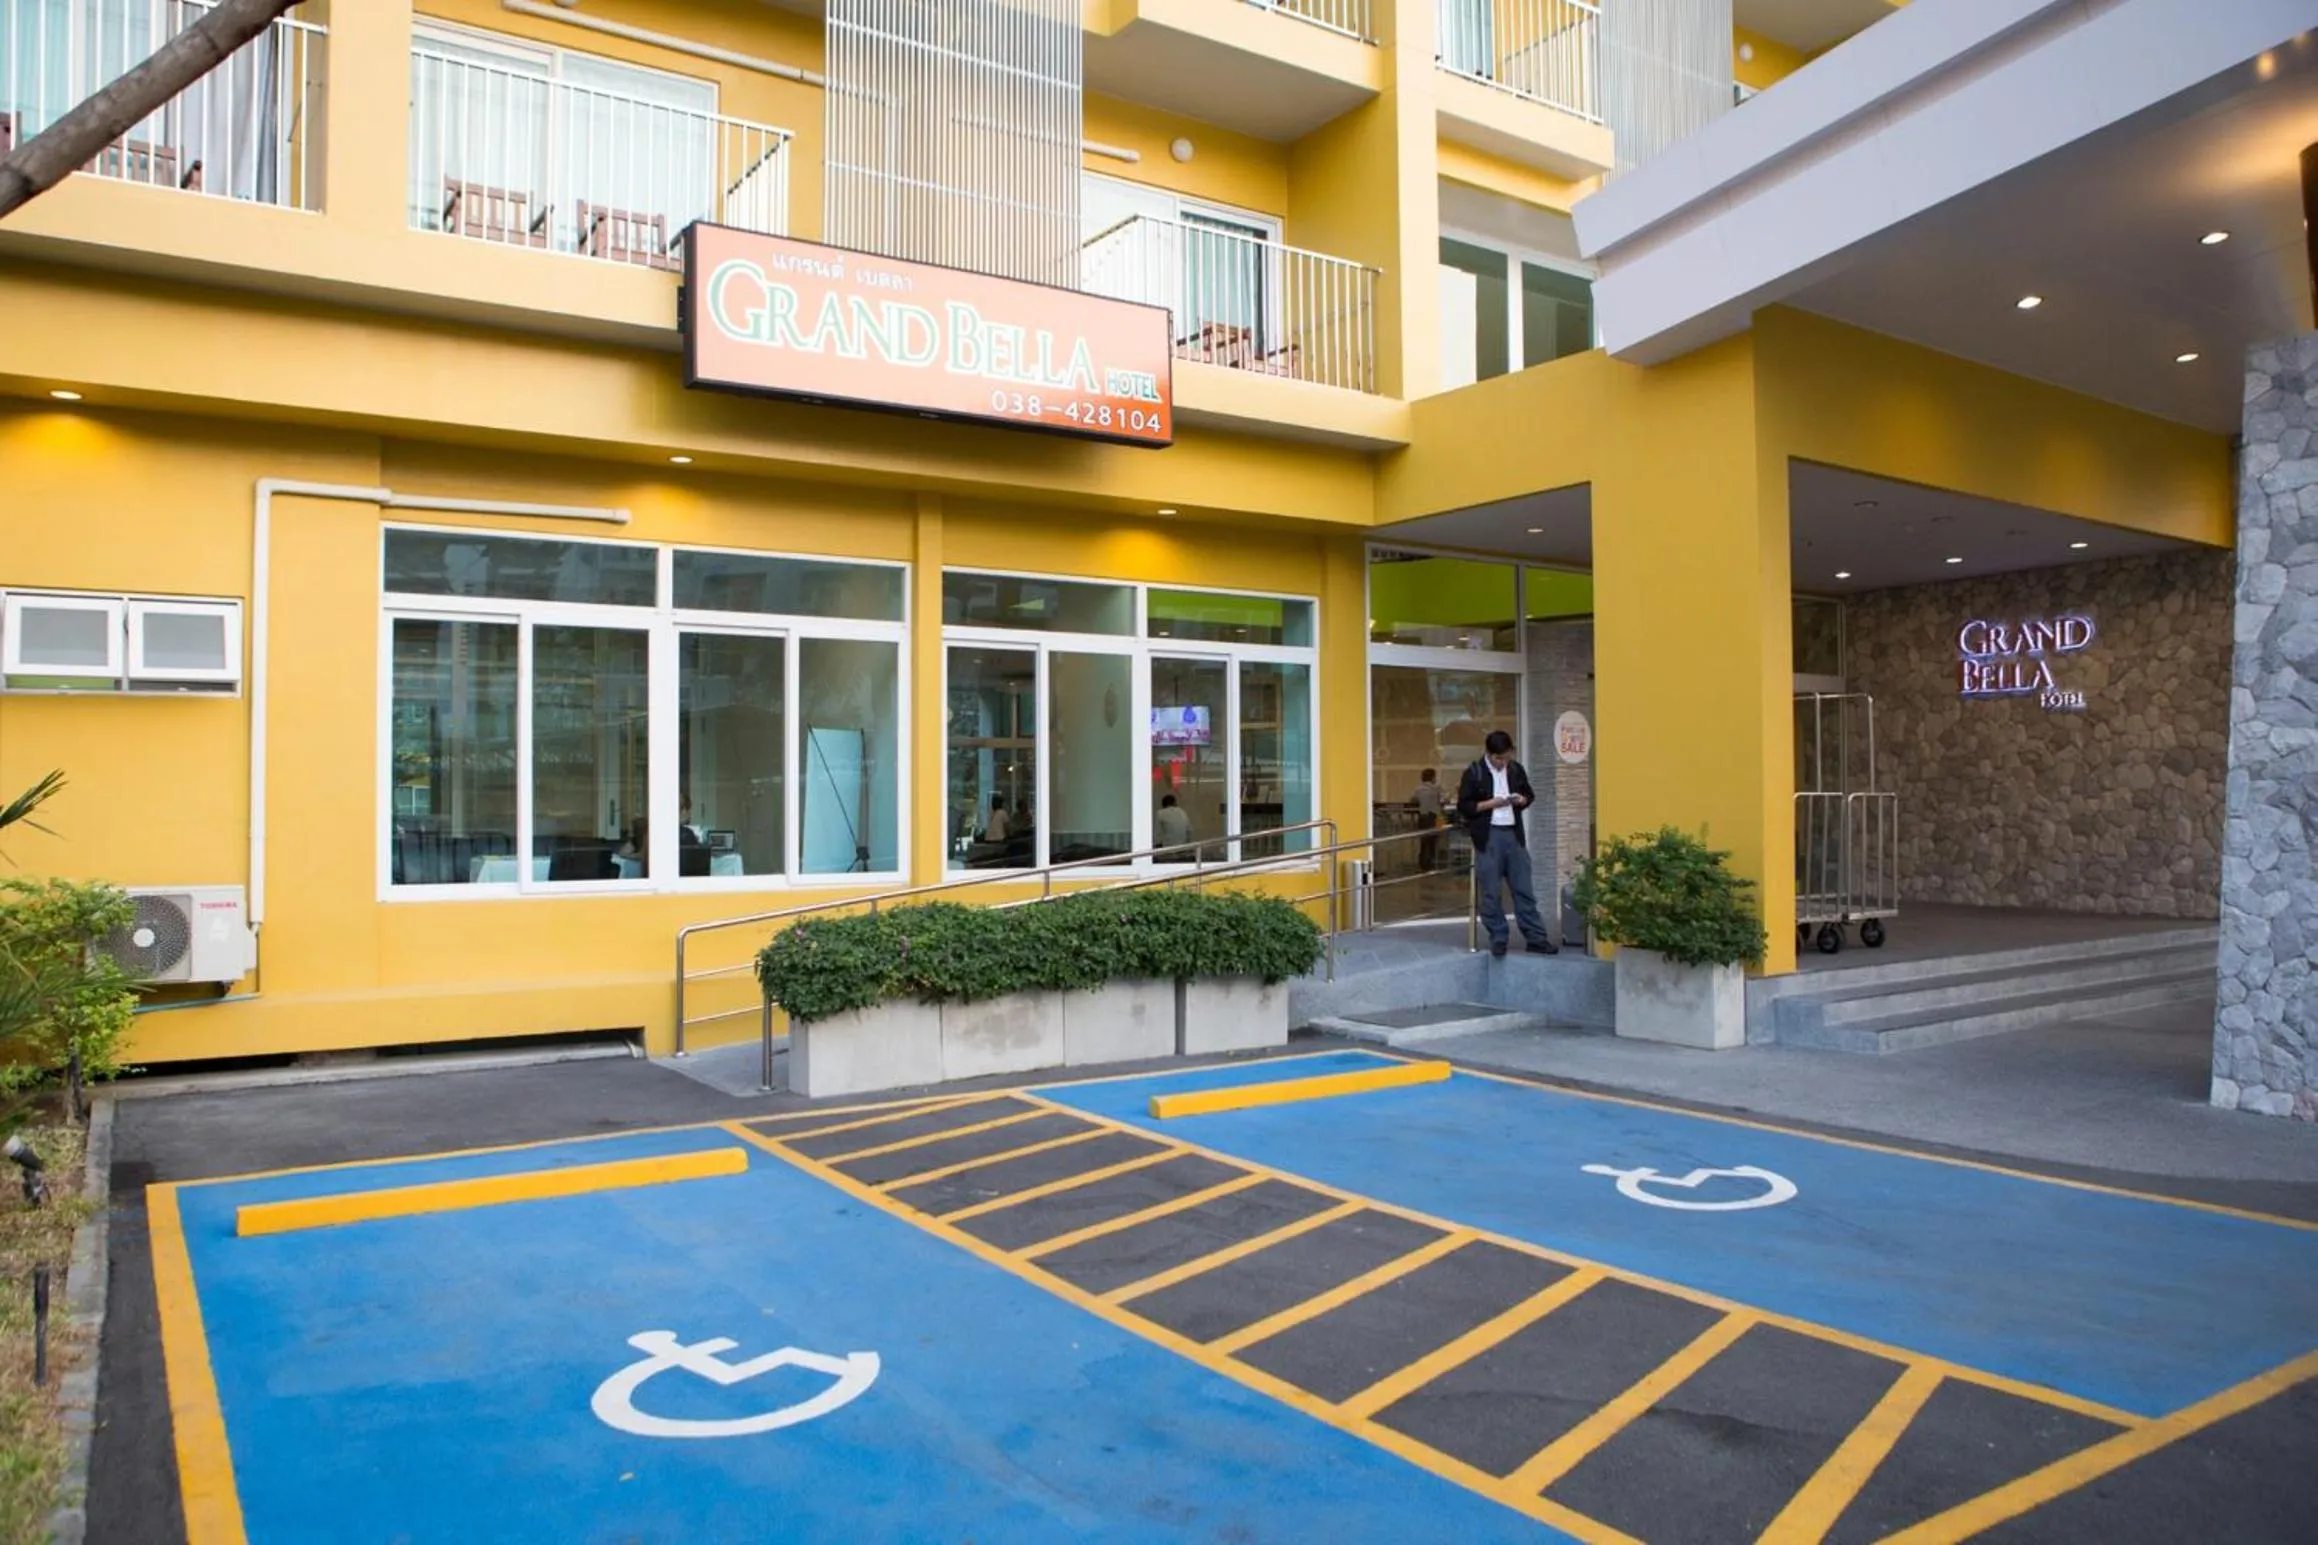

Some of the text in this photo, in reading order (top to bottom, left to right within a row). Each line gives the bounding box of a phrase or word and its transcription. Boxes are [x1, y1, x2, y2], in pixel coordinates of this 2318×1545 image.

[707, 258, 1163, 403] GRAND BELLA HOTEL
[991, 390, 1161, 433] 038-428104
[1959, 616, 2092, 657] GRAND
[1961, 659, 2055, 694] BELLA
[2040, 691, 2087, 709] HOTEL
[1561, 742, 1586, 753] SALE
